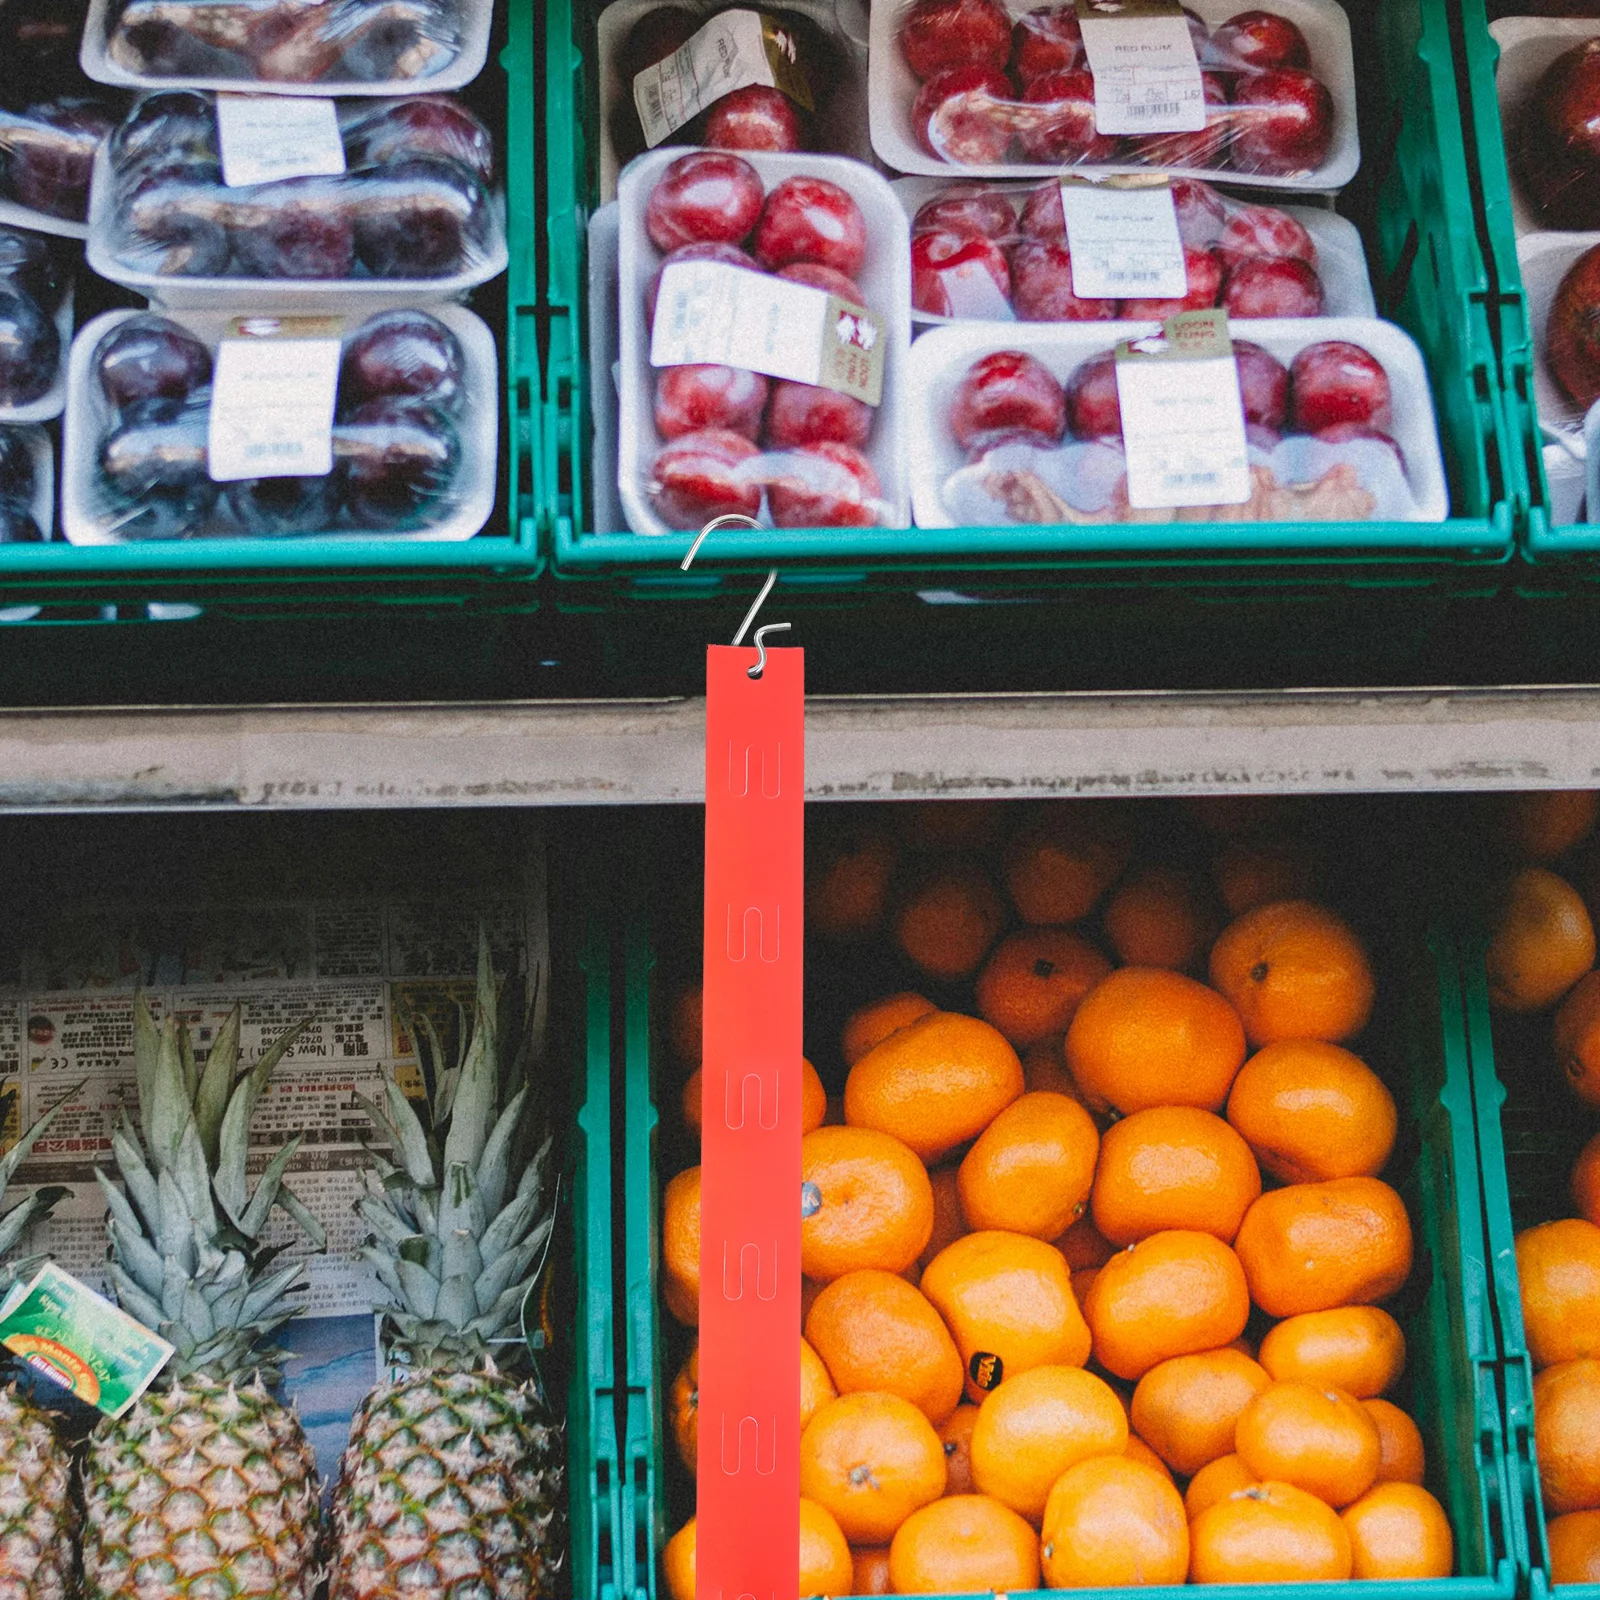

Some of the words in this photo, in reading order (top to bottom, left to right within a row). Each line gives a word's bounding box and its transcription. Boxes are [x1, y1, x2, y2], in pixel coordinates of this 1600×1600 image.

[717, 37, 728, 59] RED
[1115, 45, 1138, 53] RED
[1141, 44, 1172, 52] PLUM
